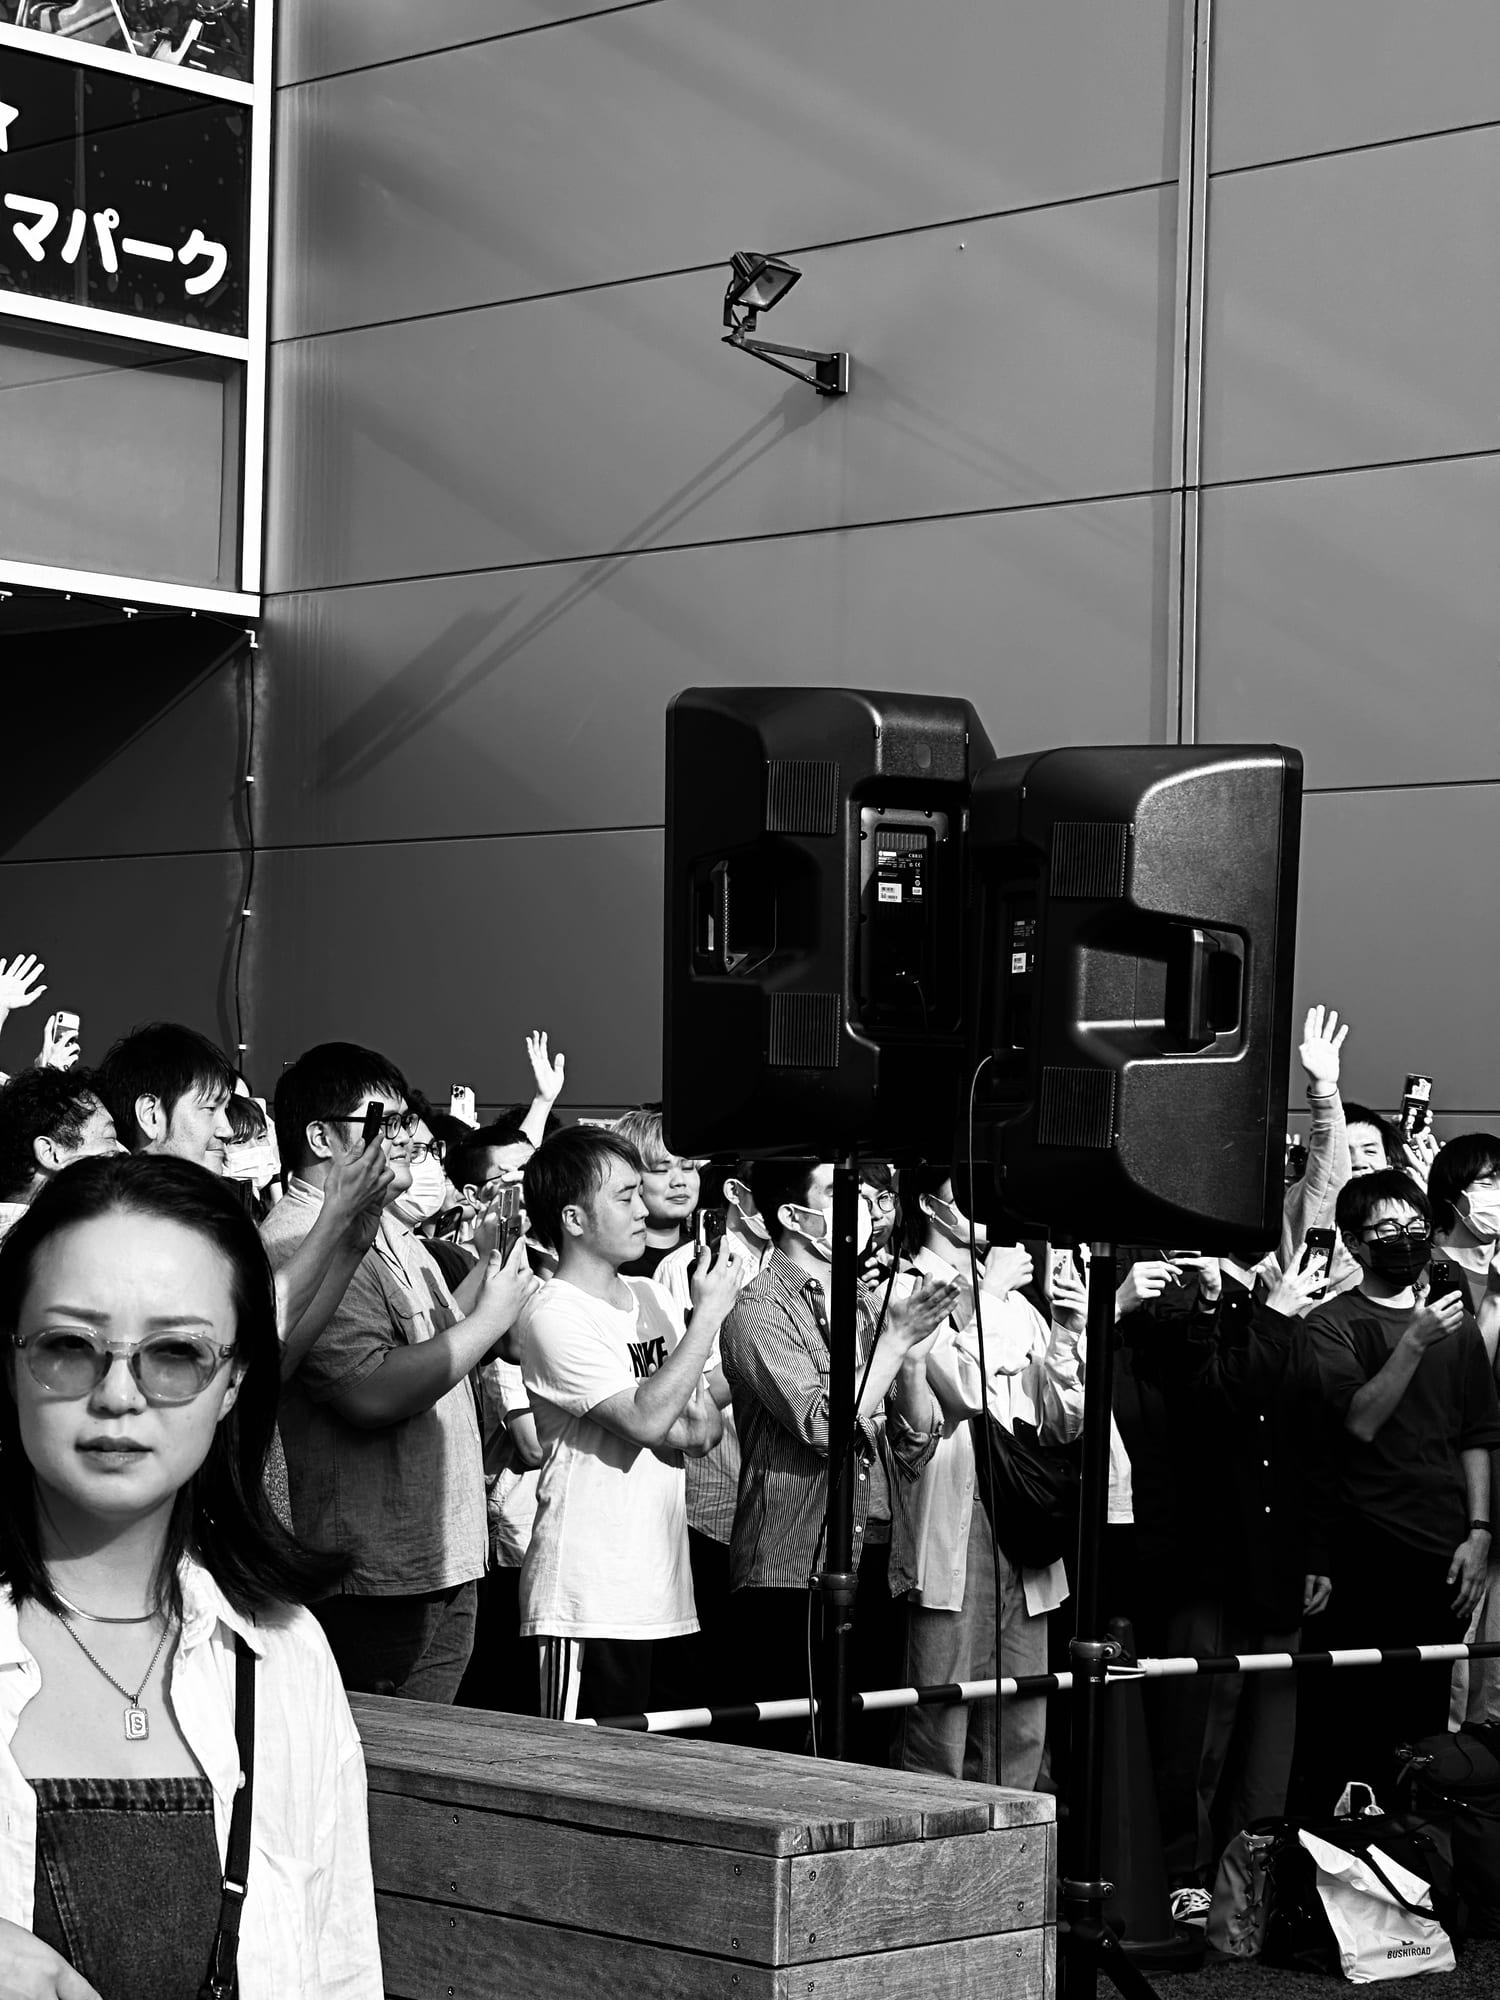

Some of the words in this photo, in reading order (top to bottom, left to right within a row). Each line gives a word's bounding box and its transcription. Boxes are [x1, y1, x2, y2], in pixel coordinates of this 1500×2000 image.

[3, 192, 228, 296] マパーク
[626, 1335, 669, 1378] NIKE
[133, 1716, 143, 1731] S
[1386, 1946, 1432, 1960] BUSHIROAD
